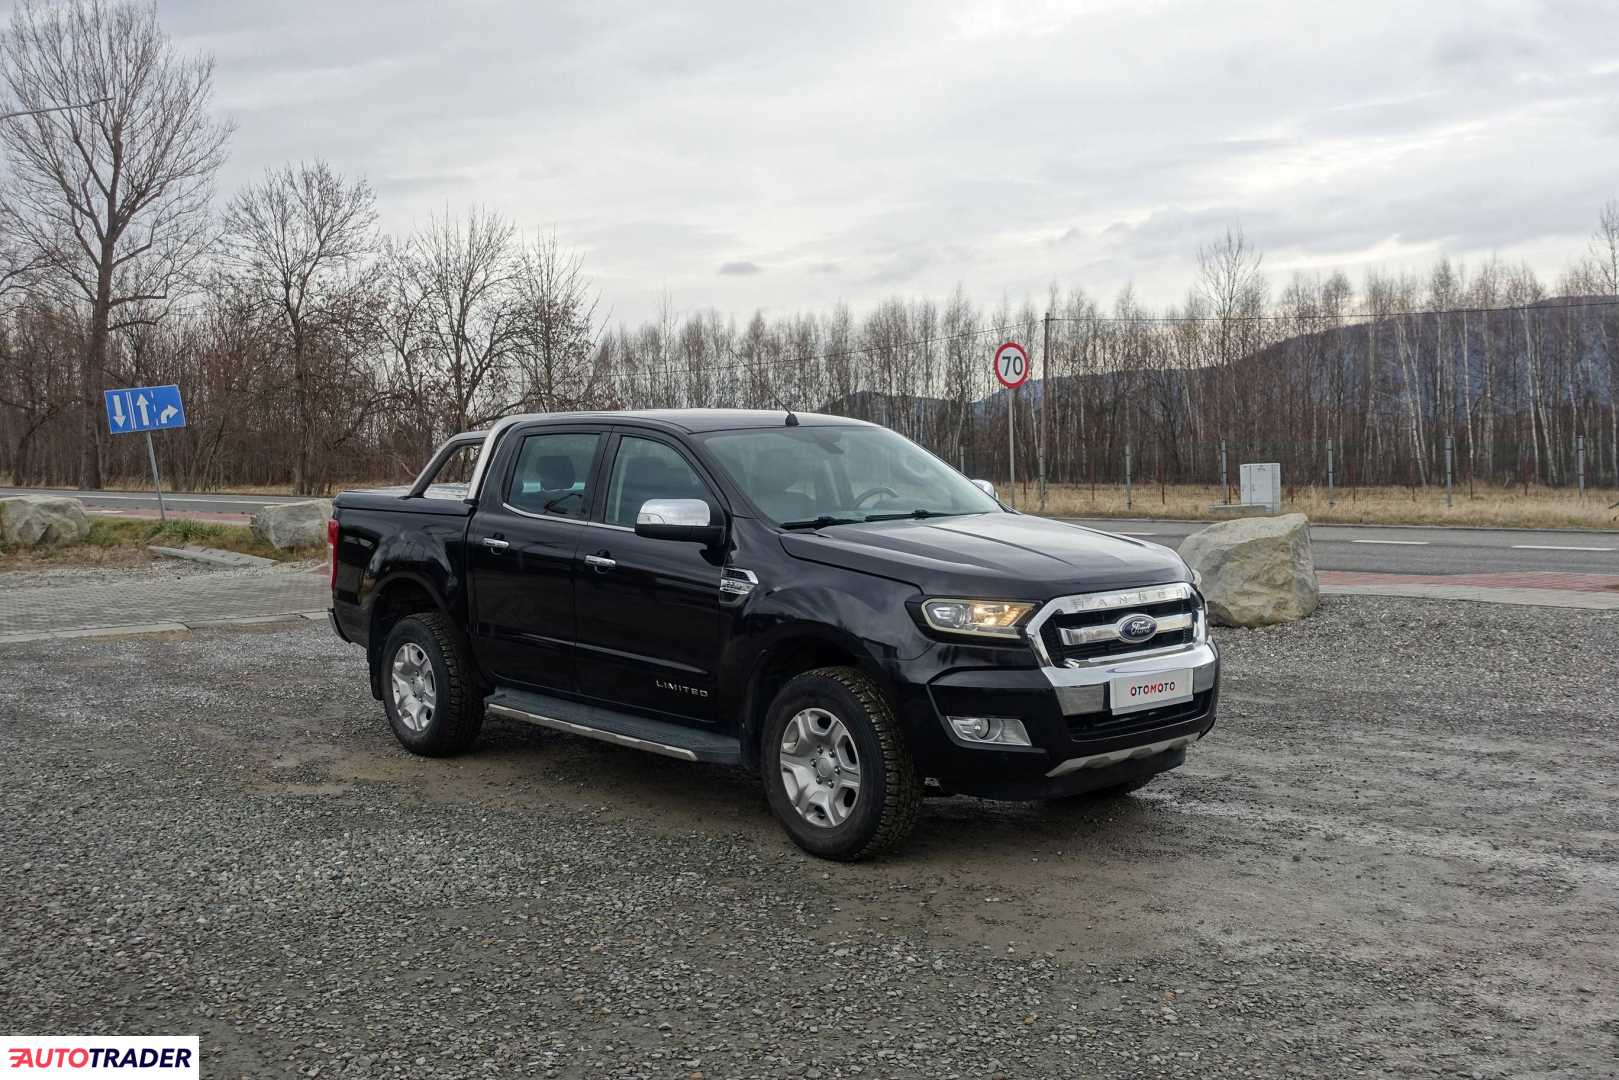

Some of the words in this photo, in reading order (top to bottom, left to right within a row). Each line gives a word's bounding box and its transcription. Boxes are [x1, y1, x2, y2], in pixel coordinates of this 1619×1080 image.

[1002, 356, 1023, 377] 70
[1130, 620, 1153, 636] Ford
[656, 680, 709, 697] LIMITED
[1130, 682, 1176, 697] OTOMOTO
